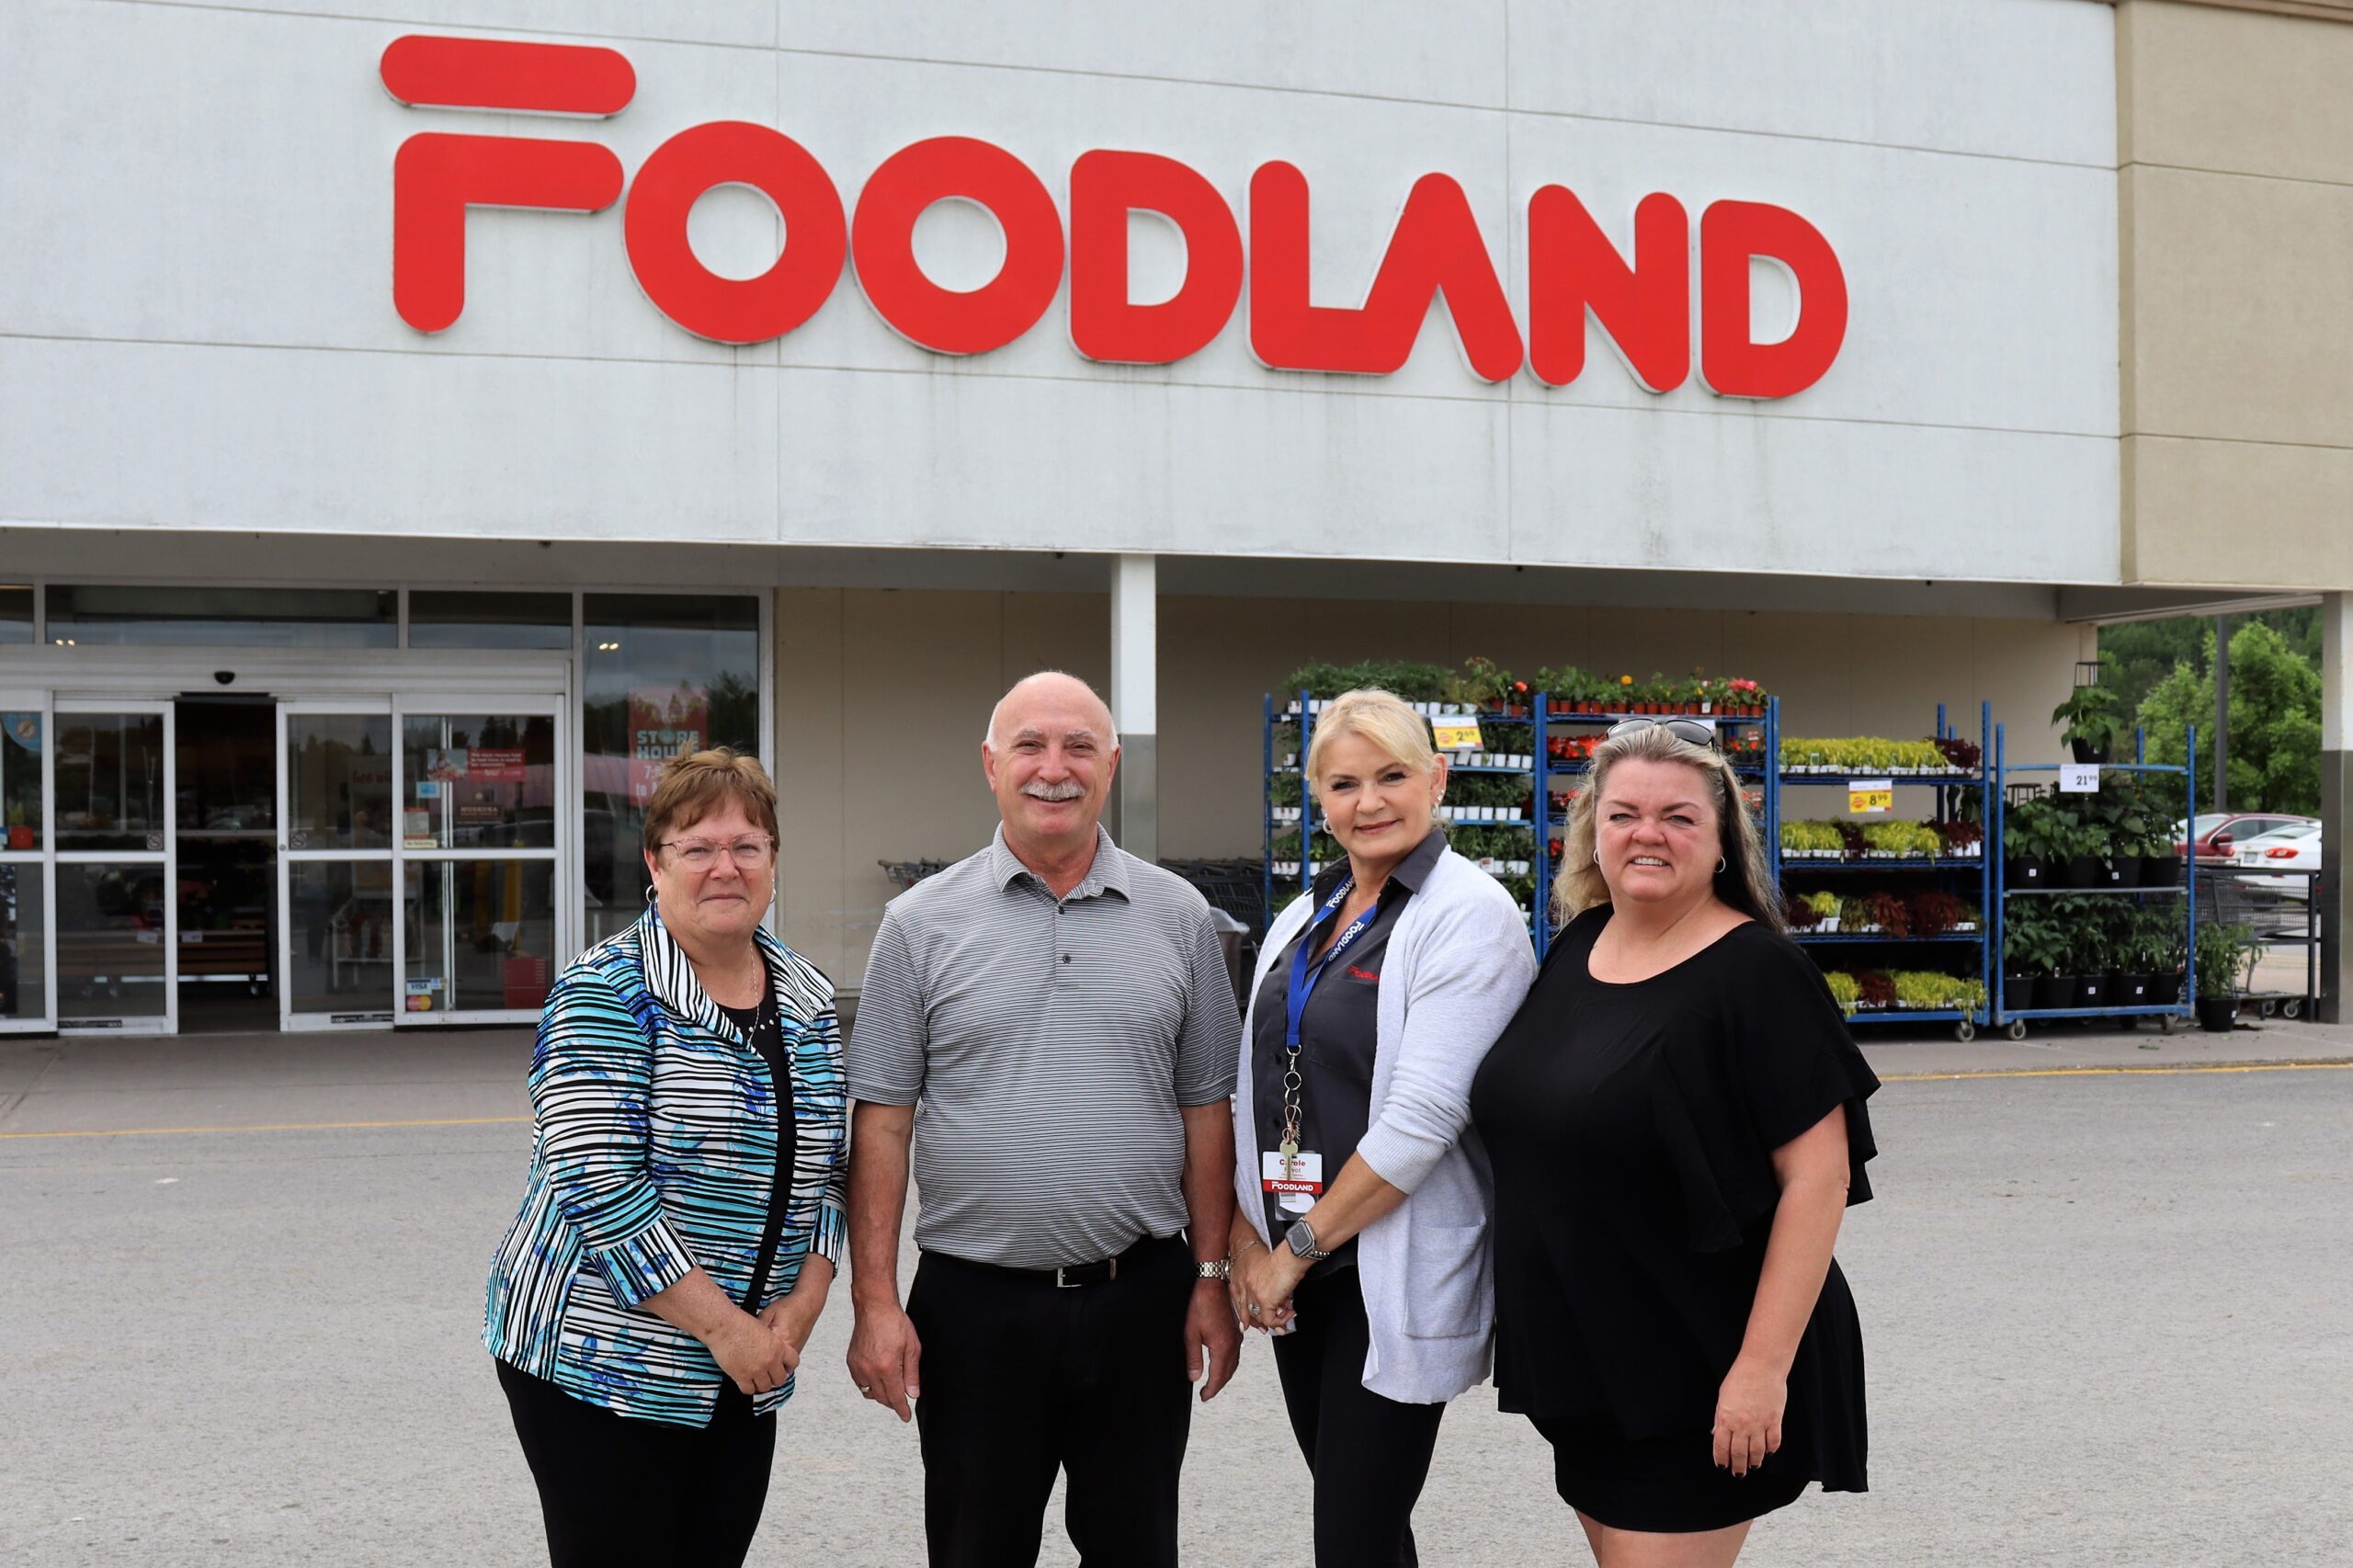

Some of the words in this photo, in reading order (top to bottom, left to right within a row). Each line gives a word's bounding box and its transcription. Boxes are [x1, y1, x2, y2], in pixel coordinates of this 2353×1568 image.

[381, 35, 1848, 398] FOODLAND
[636, 745, 699, 759] HOU
[1325, 876, 1355, 908] FOODLAN
[1328, 921, 1365, 961] FOODLAND
[1271, 1181, 1314, 1191] FOODLAND
